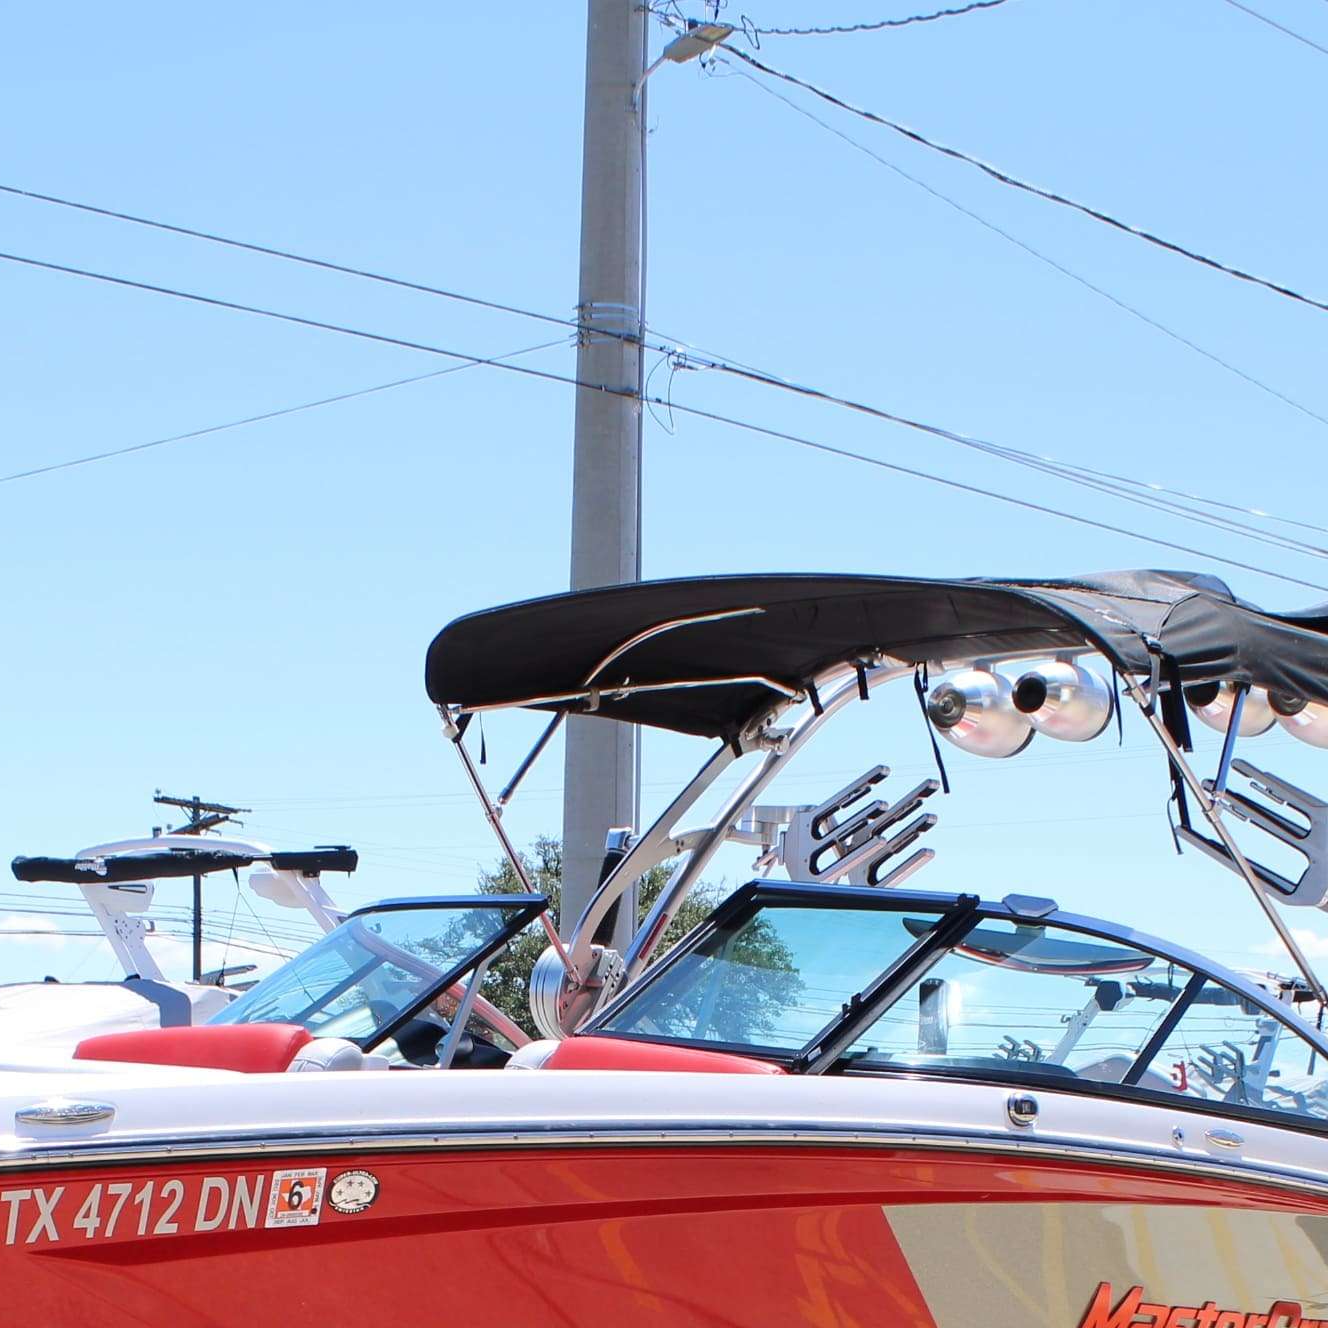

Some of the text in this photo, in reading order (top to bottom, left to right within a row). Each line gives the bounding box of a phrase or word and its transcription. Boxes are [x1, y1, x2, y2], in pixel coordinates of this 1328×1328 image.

[0, 1186, 65, 1245] TX
[73, 1179, 184, 1239] 4712
[194, 1174, 265, 1232] DN
[288, 1180, 304, 1210] 6
